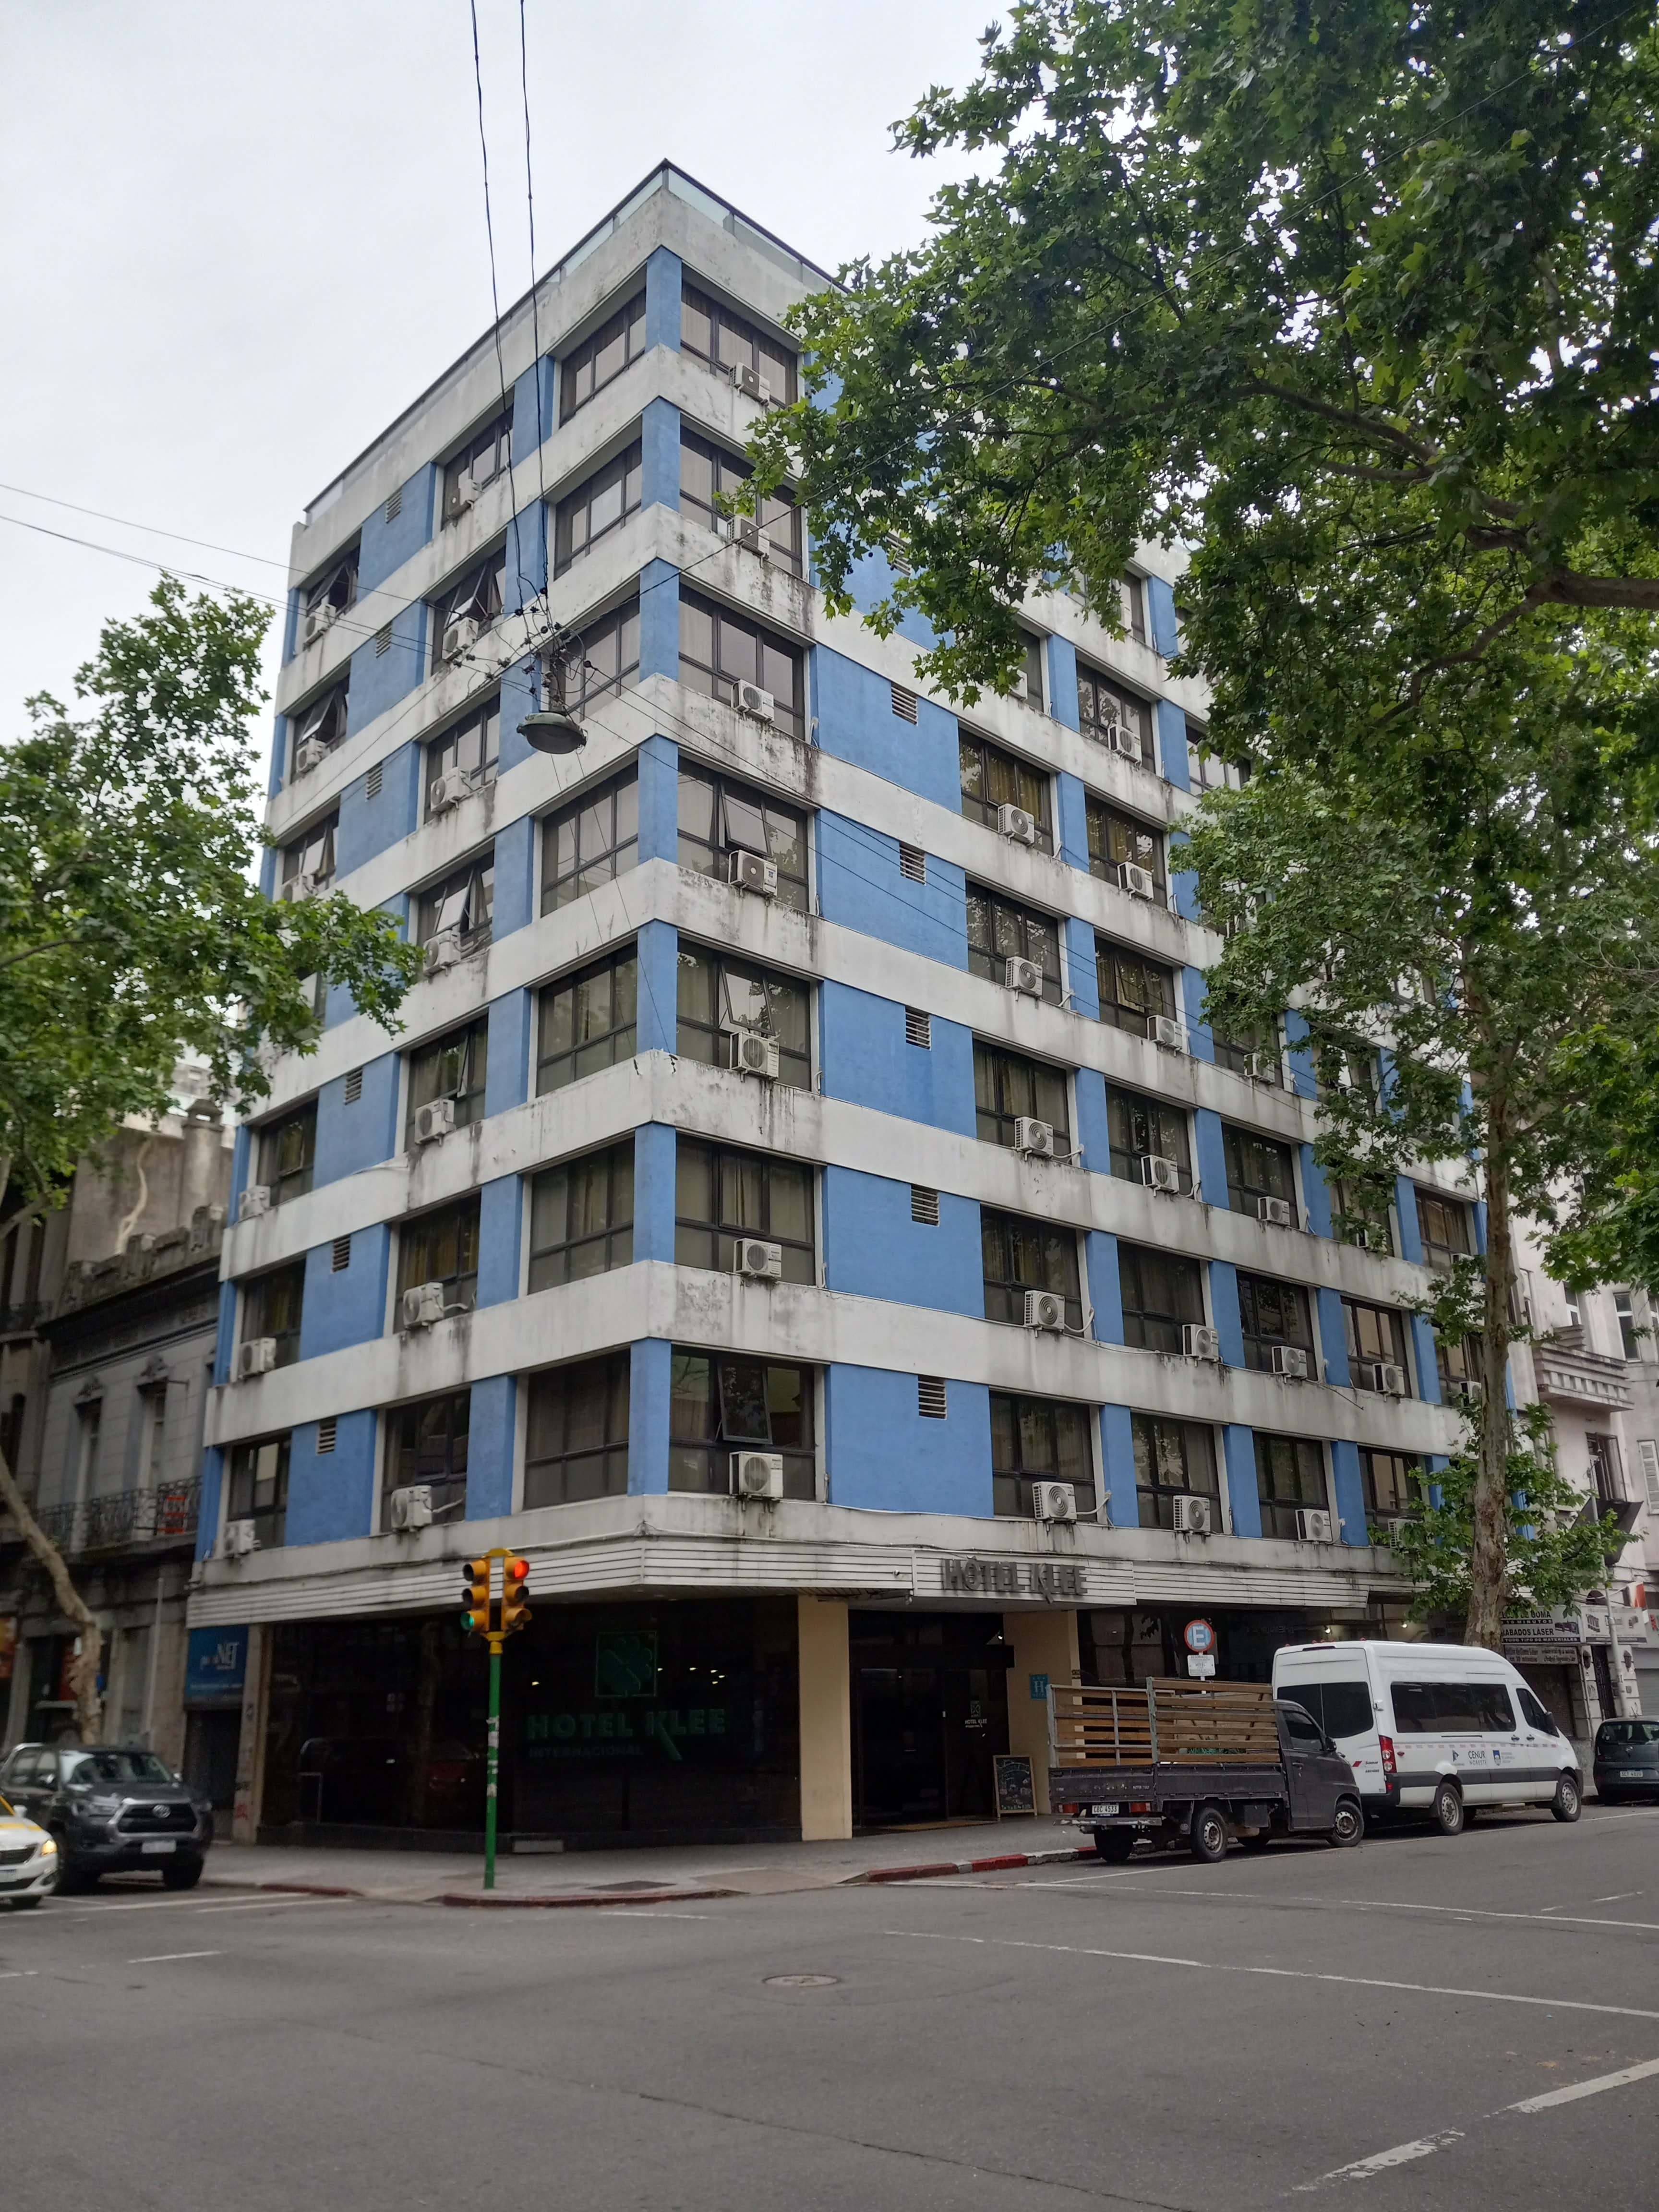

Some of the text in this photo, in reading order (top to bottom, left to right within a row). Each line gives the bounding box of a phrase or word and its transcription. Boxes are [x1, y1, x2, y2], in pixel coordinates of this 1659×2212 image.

[941, 1559, 1088, 1604] HOTEL KLEE
[1530, 1610, 1551, 1618] GOMA
[1192, 1625, 1205, 1647] E
[526, 1708, 727, 1761] HOTEL KLEE
[1468, 1750, 1486, 1759] CENUR
